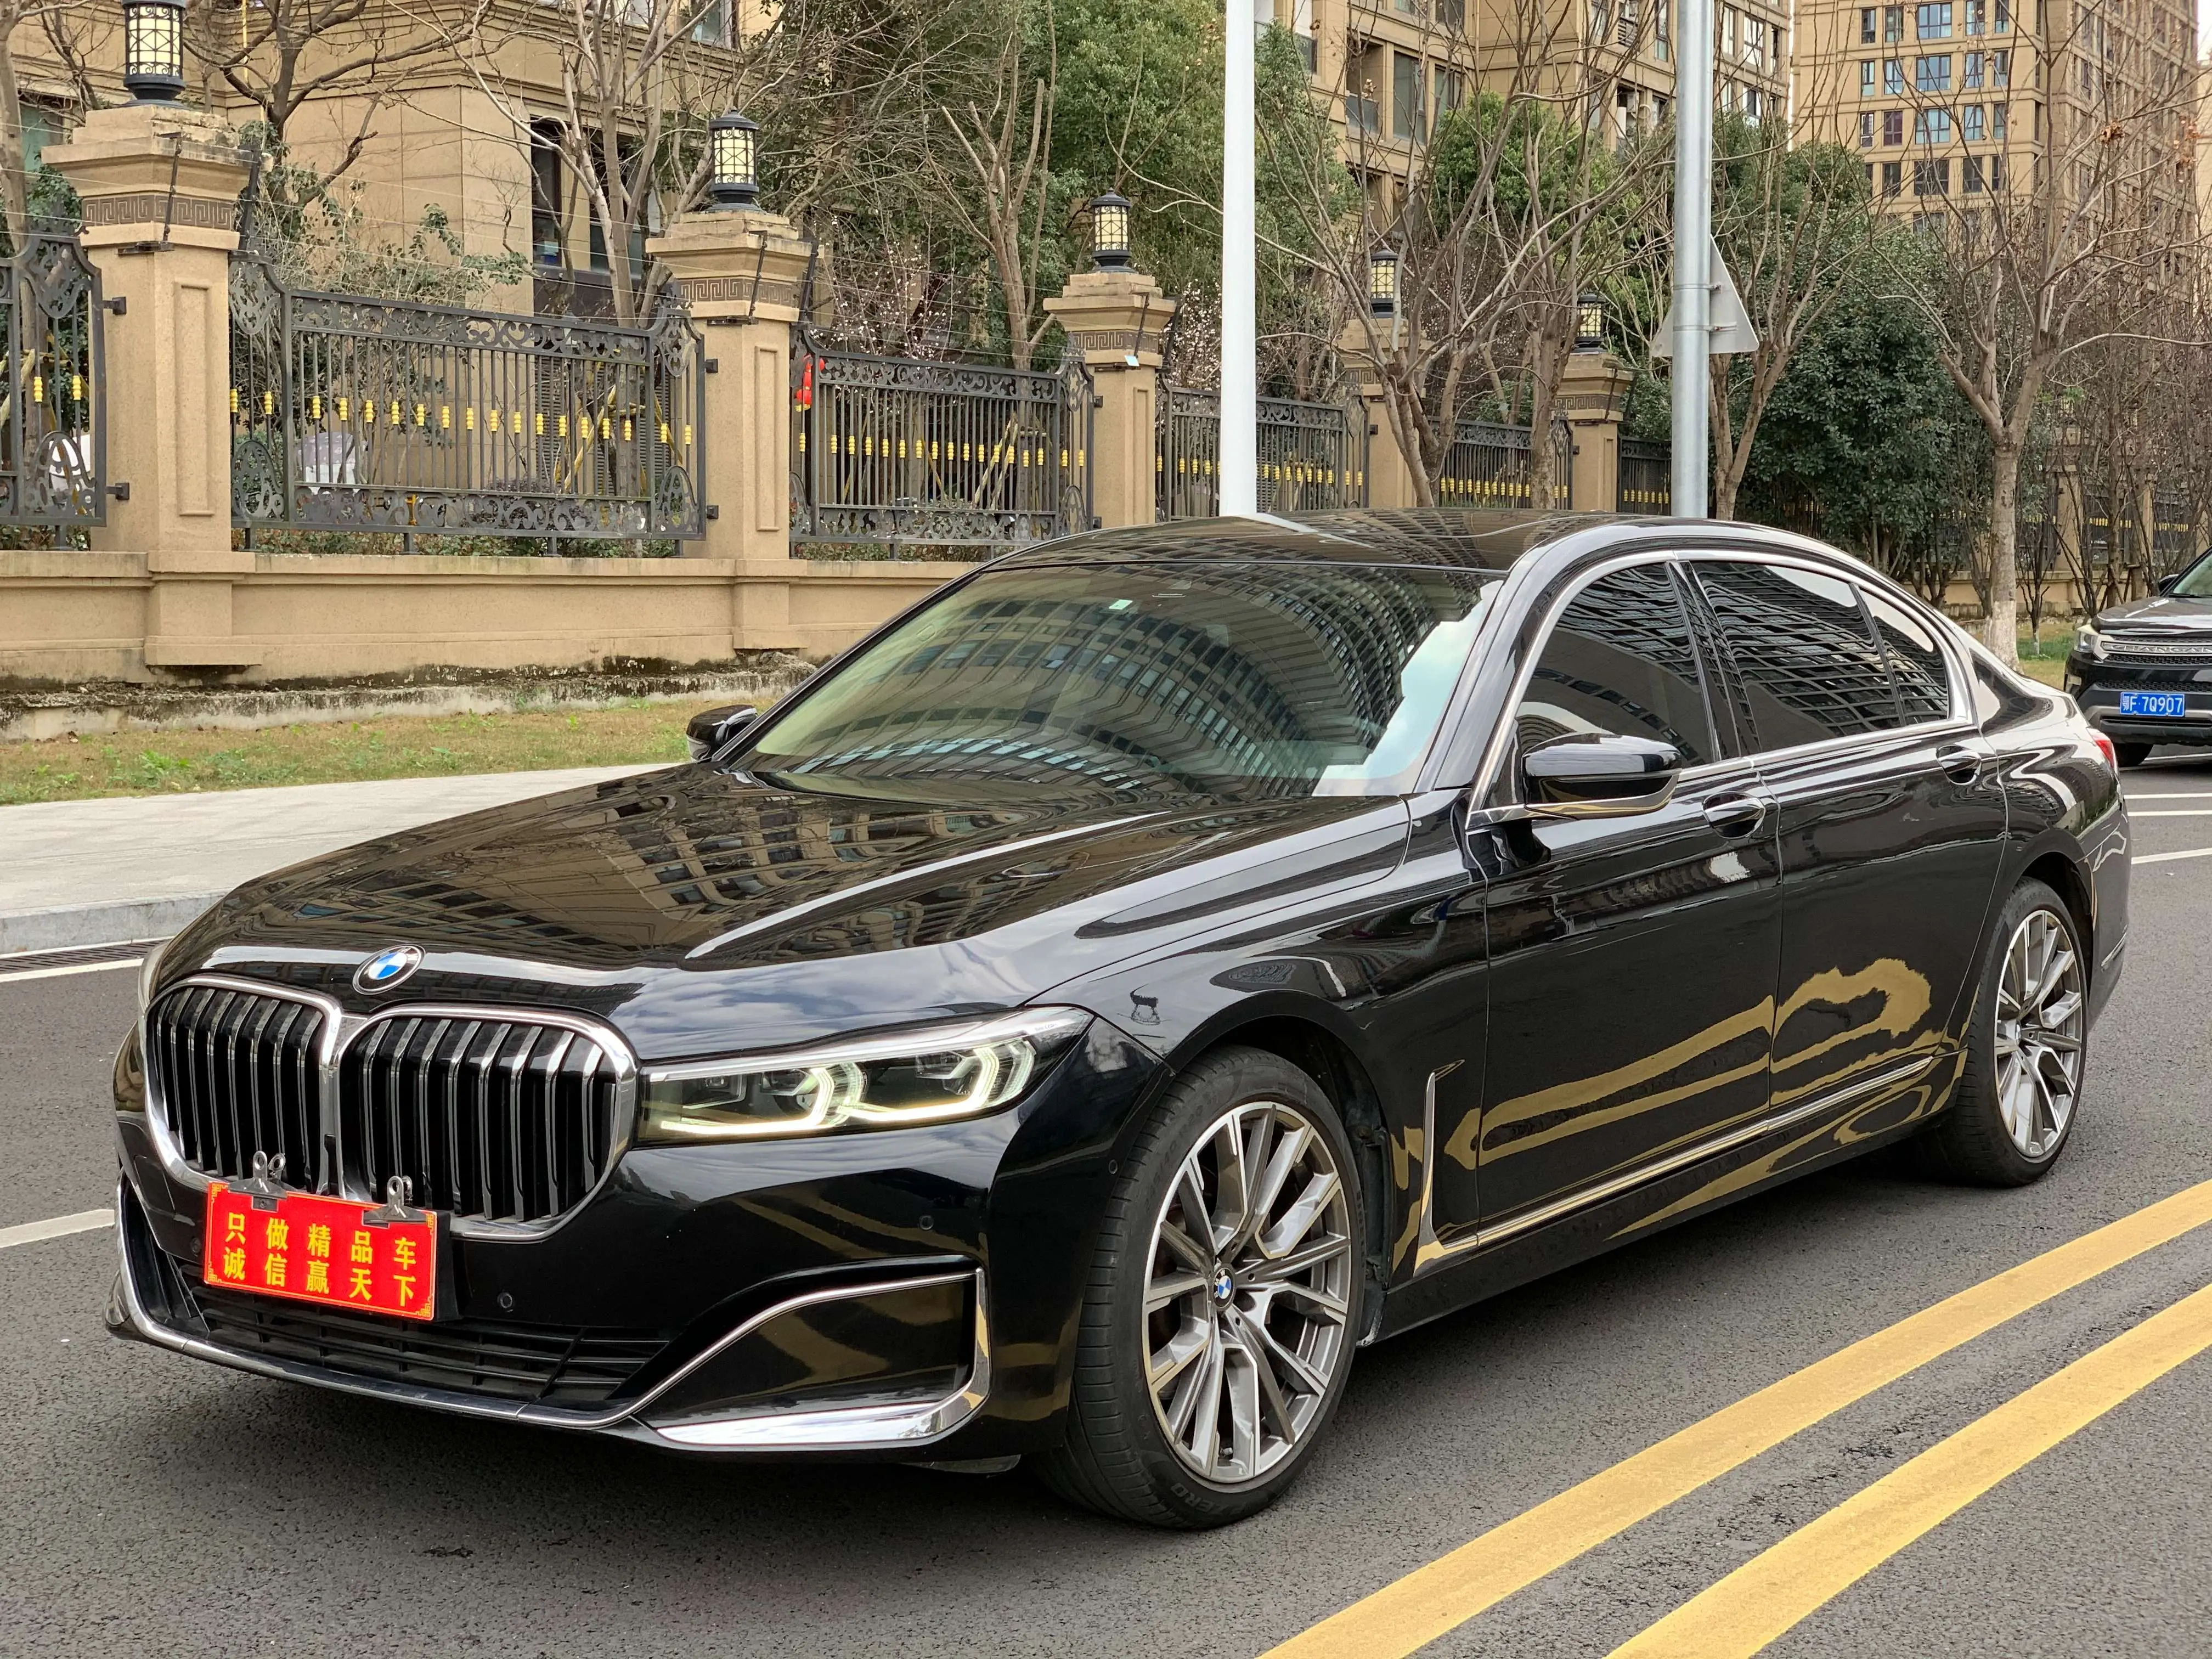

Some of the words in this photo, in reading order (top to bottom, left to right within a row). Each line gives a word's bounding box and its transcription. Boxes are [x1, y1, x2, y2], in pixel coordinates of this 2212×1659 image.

[225, 1212, 417, 1271] 只做精品车
[223, 1246, 417, 1306] 诚信赢天下
